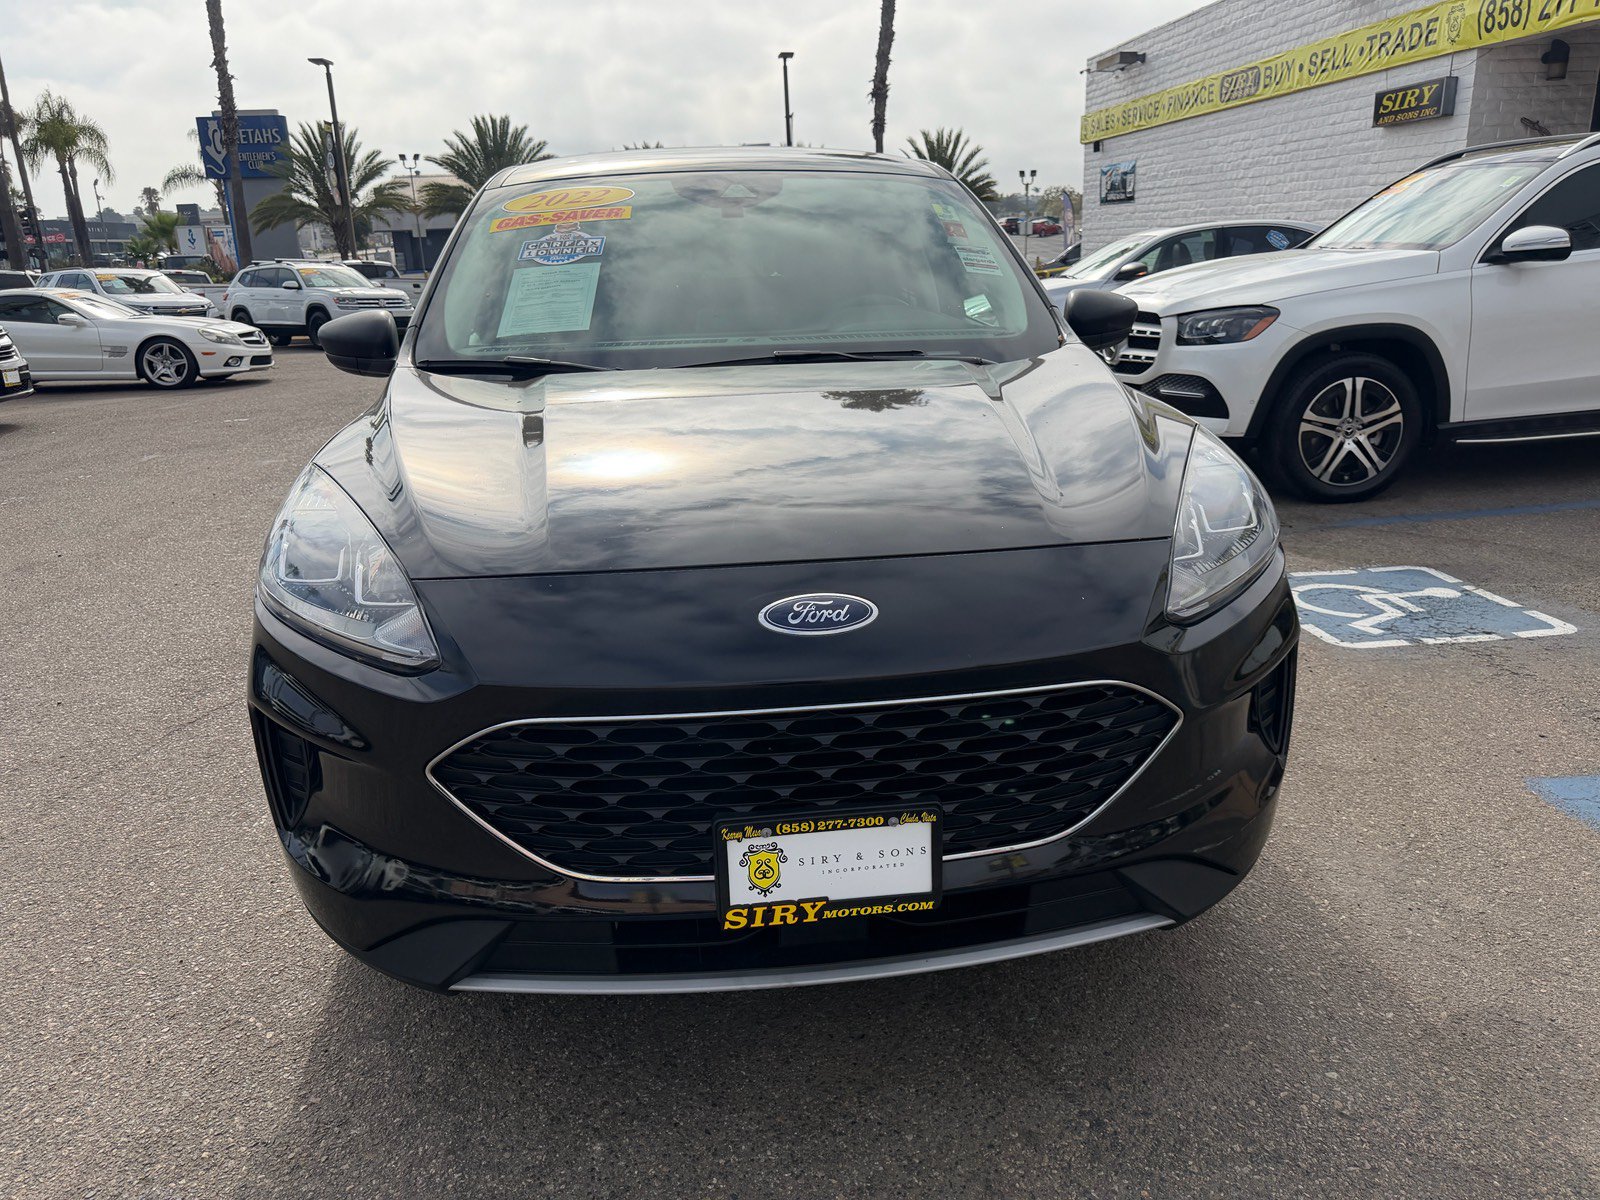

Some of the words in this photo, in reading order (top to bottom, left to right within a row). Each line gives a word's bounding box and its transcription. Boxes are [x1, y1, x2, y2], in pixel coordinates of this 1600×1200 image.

[1477, 0, 1531, 40] (858)
[1090, 113, 1116, 135] SALES
[1121, 100, 1160, 127] SERVICE
[1167, 83, 1215, 115] FINANCE
[1263, 58, 1296, 89] BUY
[1308, 43, 1353, 77] SELL
[1365, 16, 1440, 62] TRADE
[1379, 84, 1439, 114] SIRY
[1377, 115, 1395, 125] AND
[1396, 110, 1420, 121] SONS
[1420, 107, 1437, 117] INC
[238, 151, 276, 162] ENTLEMEN'S
[521, 189, 612, 210] 2022
[495, 206, 627, 231] GAS-SAVER
[527, 240, 600, 250] CARFAX
[537, 247, 598, 256] OWNER
[787, 600, 850, 625] Ford
[744, 825, 762, 838] Mesa
[775, 820, 815, 835] (858)
[817, 816, 885, 832] 277-7300
[900, 812, 919, 825] Chula
[920, 811, 937, 823] Vista
[798, 854, 841, 867] SIRY
[856, 852, 864, 861] &
[878, 846, 927, 859] SONS
[821, 862, 905, 875] INCORPORATED
